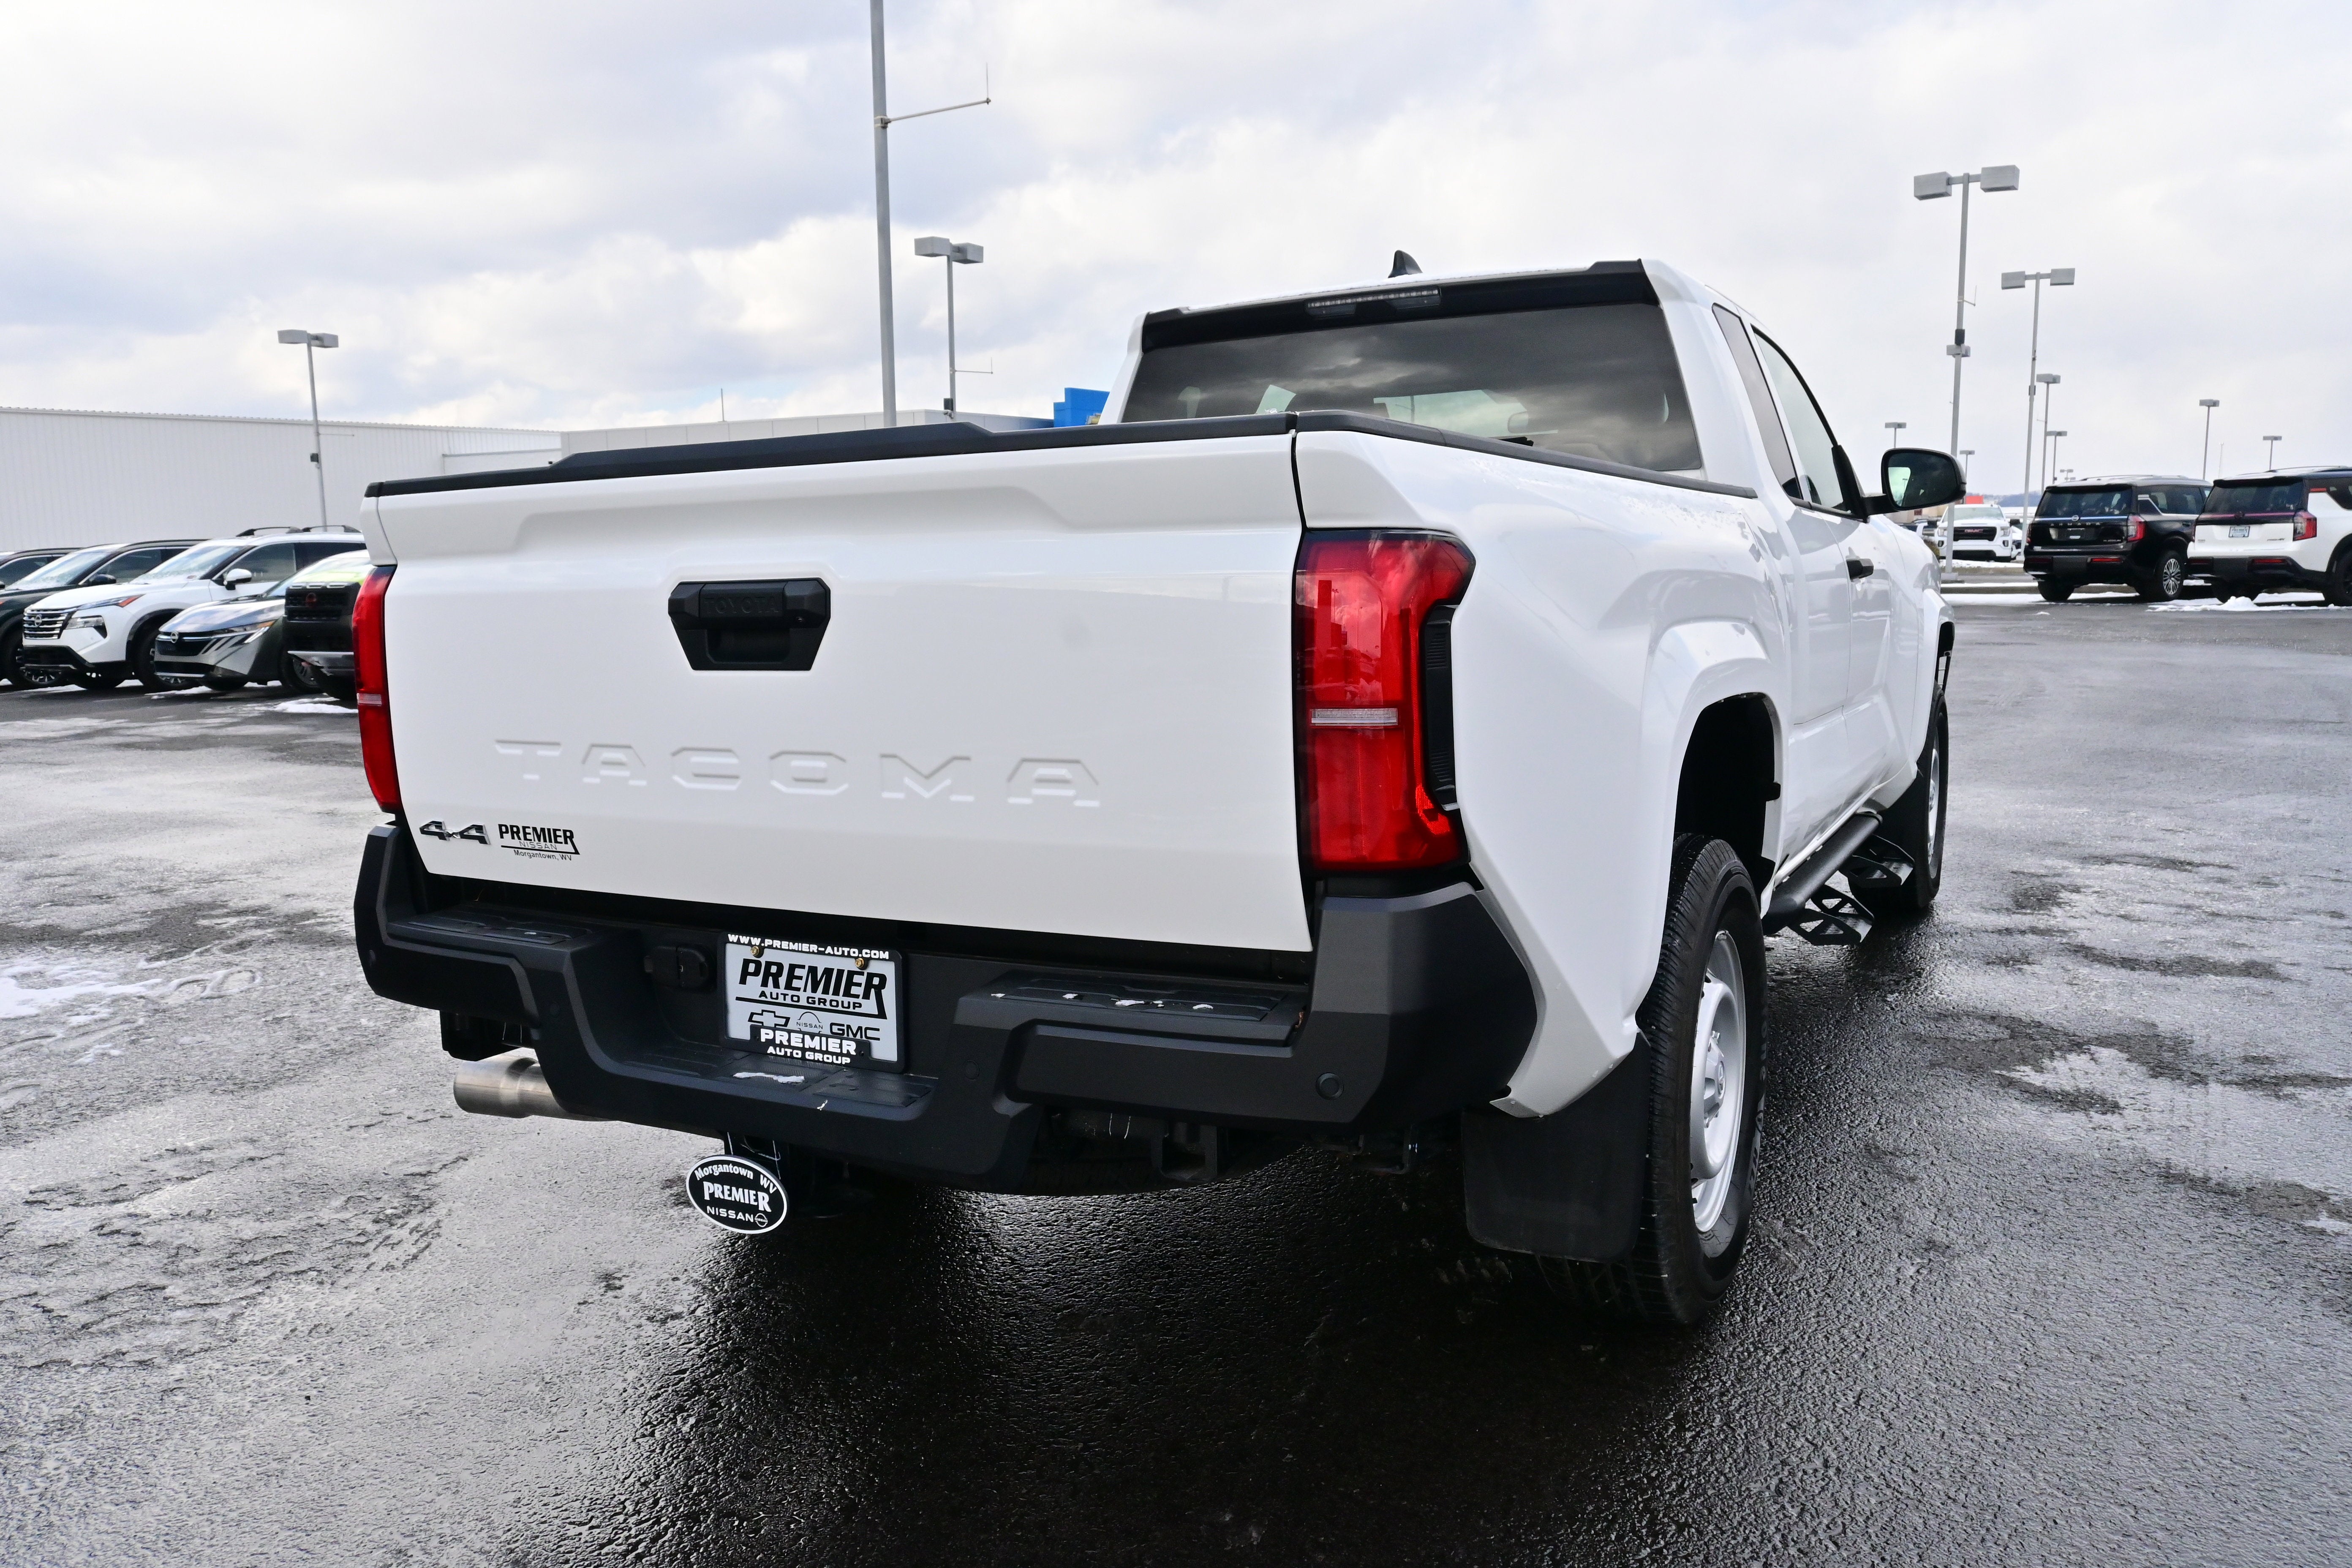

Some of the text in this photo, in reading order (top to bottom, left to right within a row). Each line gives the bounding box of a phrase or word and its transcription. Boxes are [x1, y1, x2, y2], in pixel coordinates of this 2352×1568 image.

[703, 596, 779, 614] TOYOTA
[495, 739, 1101, 807] TACOMA
[498, 823, 576, 846] PREMIER
[513, 849, 559, 861] Morgantown,
[519, 840, 558, 851] NISSAN
[727, 934, 889, 960] WWW.PREMIER-AUTO.COM
[738, 958, 887, 1001] PREMIER
[758, 990, 862, 1010] AUTO GROUP
[796, 1021, 824, 1030] NISSAN
[829, 1022, 880, 1041] GMC
[760, 1029, 857, 1055] PREMIER
[767, 1045, 851, 1065] AUTO GROUP
[694, 1163, 778, 1194] Morgantown WV
[702, 1181, 772, 1212] PREMIER
[706, 1205, 754, 1222] NISSAN
